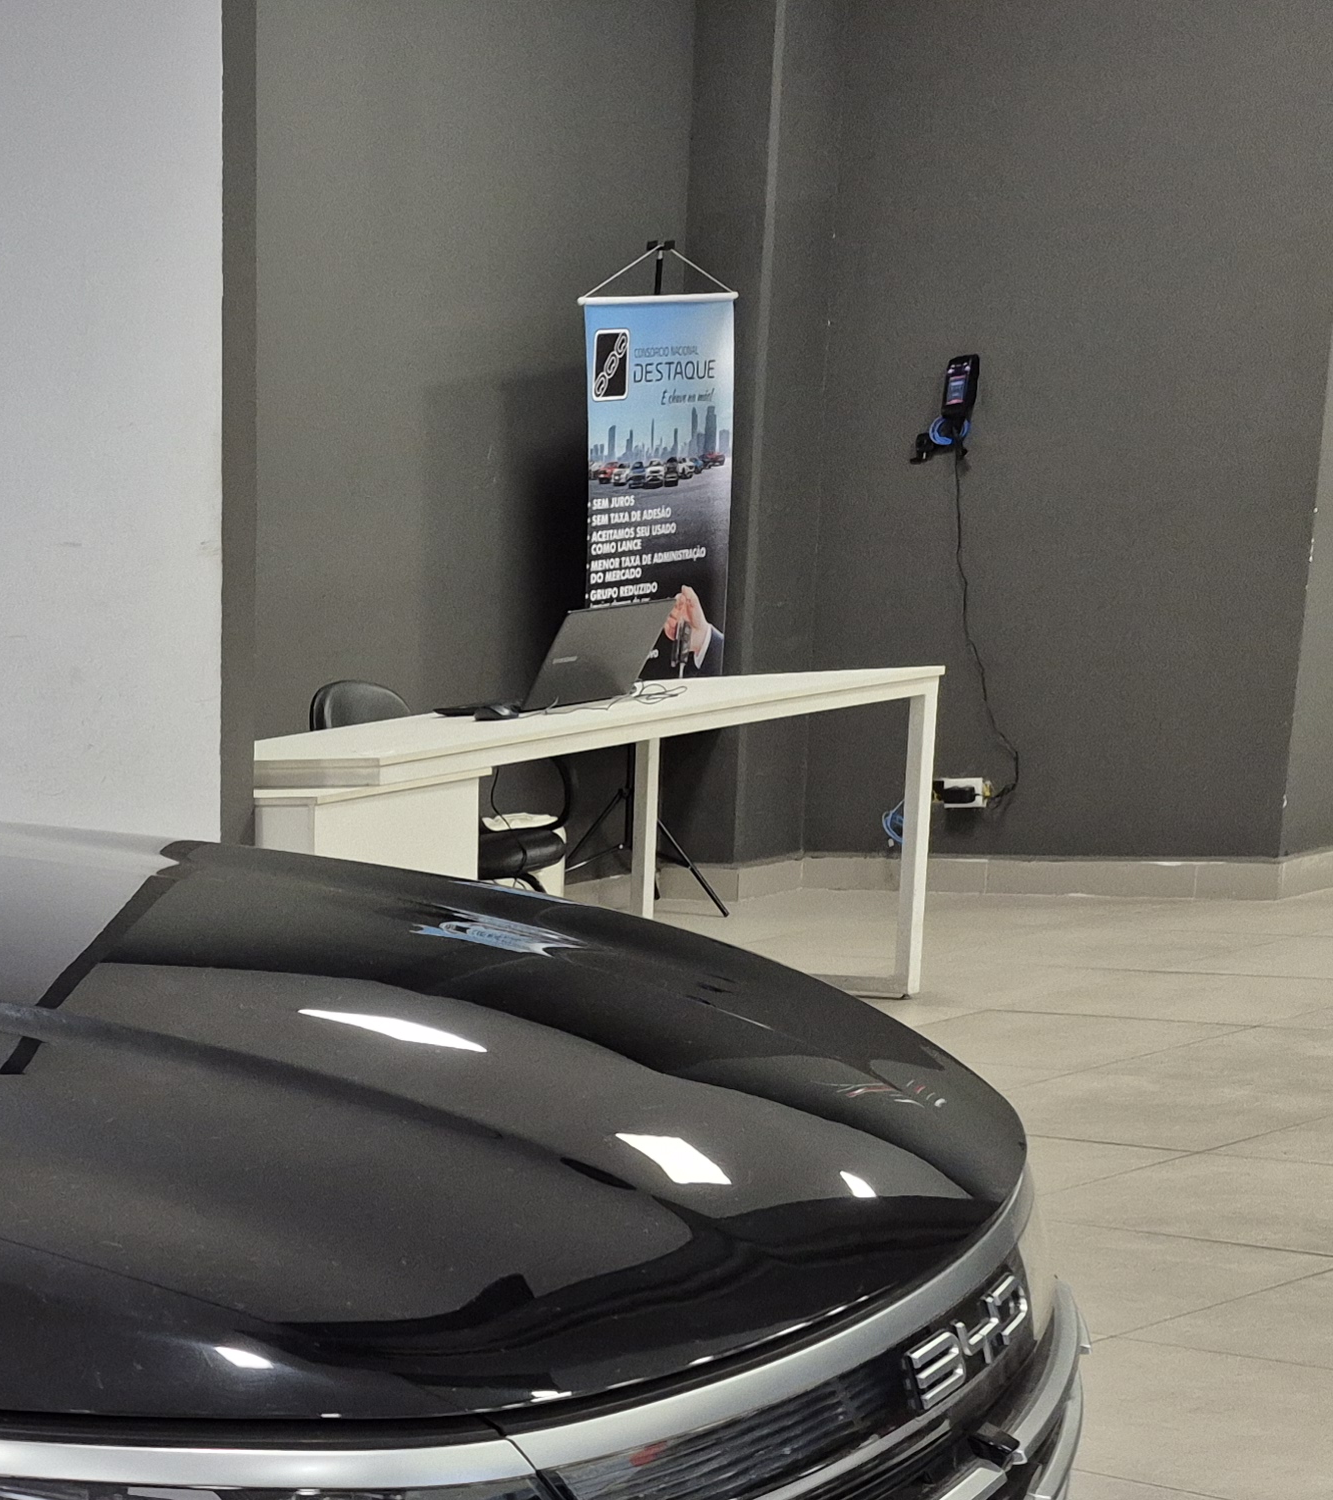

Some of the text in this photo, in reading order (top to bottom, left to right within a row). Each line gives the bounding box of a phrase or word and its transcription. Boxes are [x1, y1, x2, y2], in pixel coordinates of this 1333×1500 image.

[633, 360, 716, 383] DESTAQUE
[592, 495, 635, 510] SEM JUROS
[591, 505, 671, 527] SEM TAXA DE ADESÃO
[591, 522, 677, 542] ACEITAMOS SEU USADO
[591, 539, 642, 555] COMO LANCE
[590, 545, 707, 571] MENOR TAXA DE ADMINISTRAÇÃO
[590, 567, 642, 584] DO MERCADO
[590, 582, 658, 601] GRUPO REDUZIDO
[906, 1273, 1028, 1411] BYD
